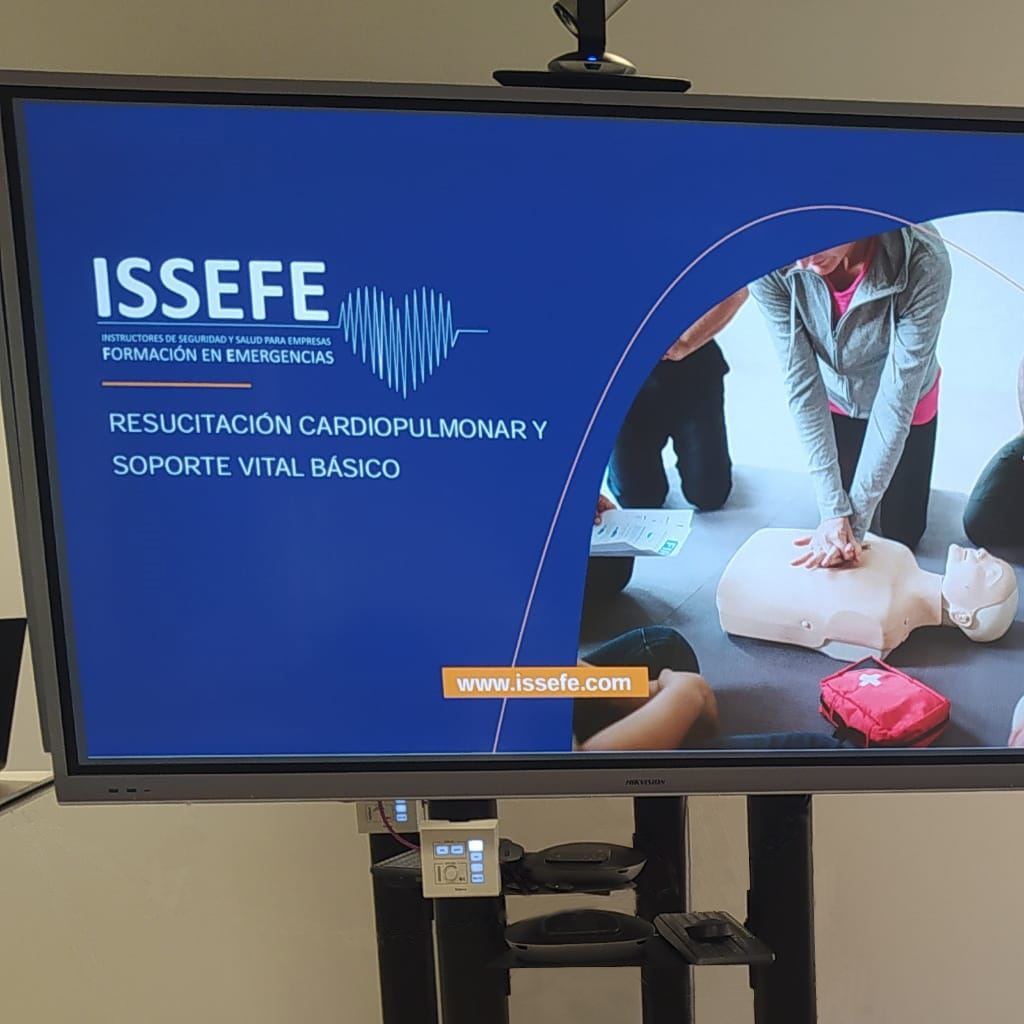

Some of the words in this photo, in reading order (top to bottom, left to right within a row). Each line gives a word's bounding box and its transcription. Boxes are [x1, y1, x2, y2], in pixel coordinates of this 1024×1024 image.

[93, 257, 329, 321] ISSEFE
[102, 333, 164, 343] INSTRUCTORES
[165, 334, 177, 343] DE
[178, 334, 227, 344] SEGURIDAD
[228, 335, 234, 344] Y
[235, 335, 263, 345] SALUD
[264, 336, 286, 345] PARA
[288, 337, 332, 346] EMPRESAS
[102, 345, 197, 361] FORMACIÓN
[202, 349, 222, 362] EN
[226, 349, 335, 364] EMERGENCIAS
[109, 412, 292, 435] RESUCITACIÓN
[299, 415, 527, 440] CARDIOPULMONAR
[532, 420, 548, 440] Y
[113, 455, 232, 476] SOPORTE
[238, 457, 305, 477] VITAL
[311, 455, 400, 479] BÁSICO
[457, 673, 632, 692] www.issefe.com
